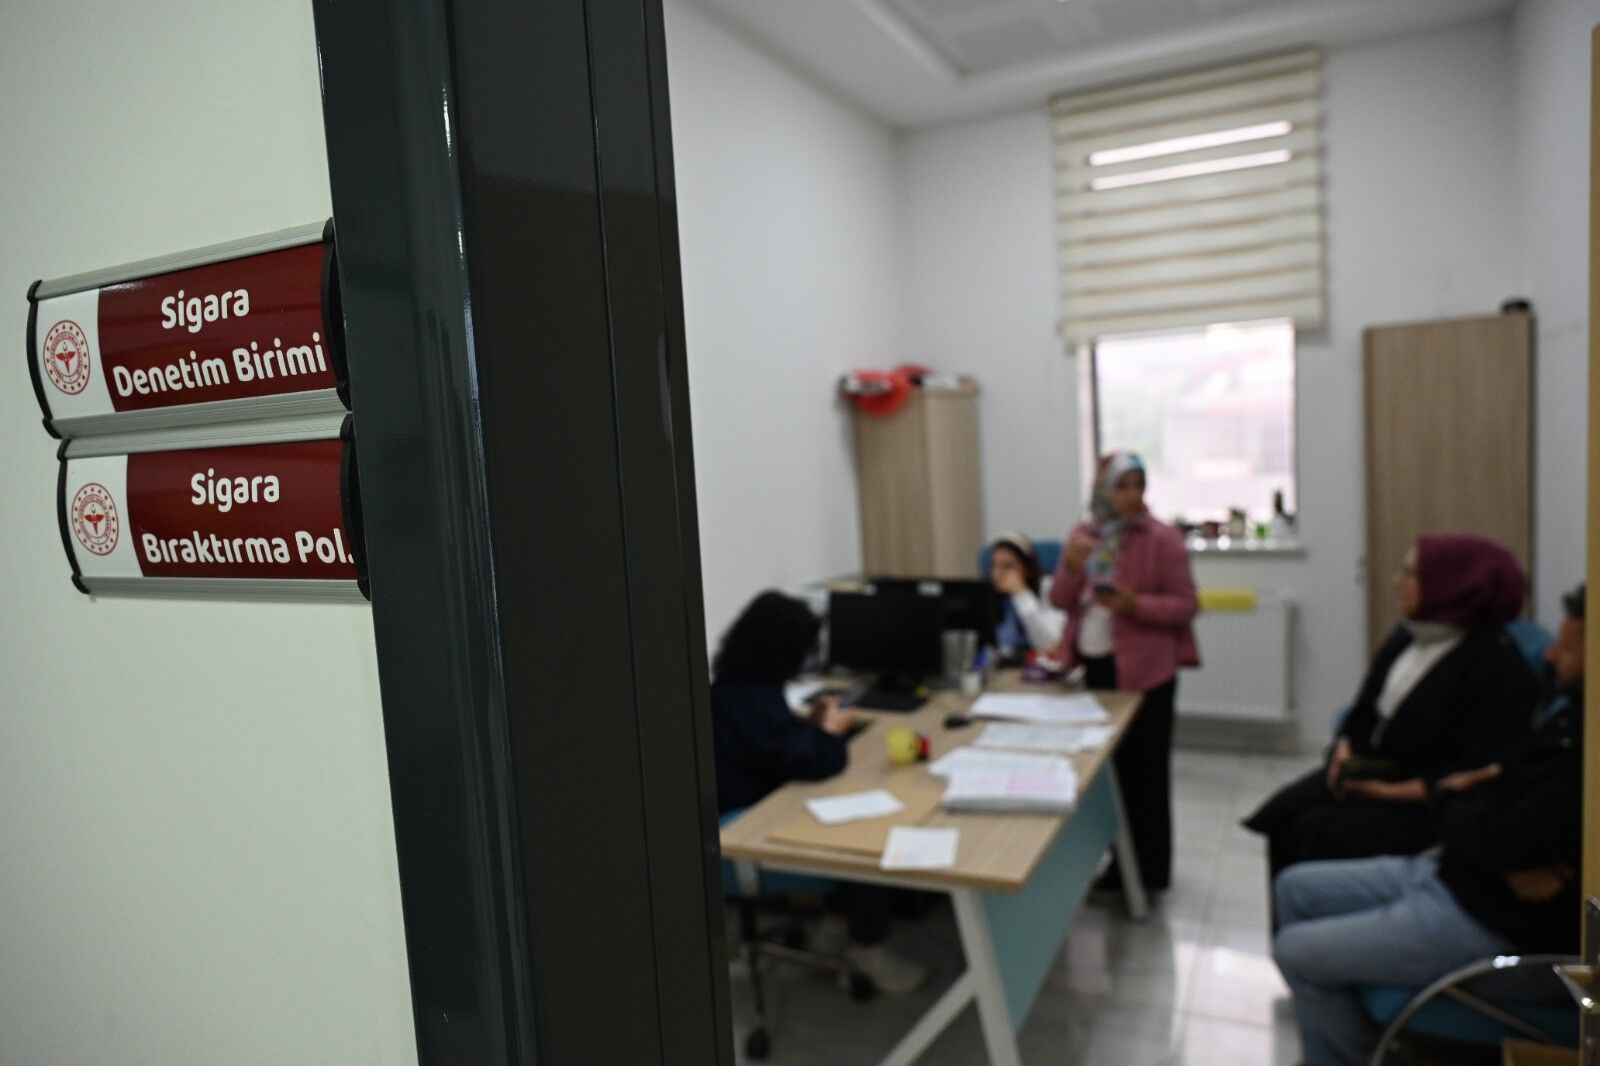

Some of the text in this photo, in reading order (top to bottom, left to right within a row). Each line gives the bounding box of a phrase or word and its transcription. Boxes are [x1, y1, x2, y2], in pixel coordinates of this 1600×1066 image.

[160, 288, 250, 334] Sigara
[112, 350, 230, 397] Denetim
[232, 331, 328, 382] Birimi
[190, 467, 280, 513] Sigara
[141, 530, 291, 564] Bıraktırma
